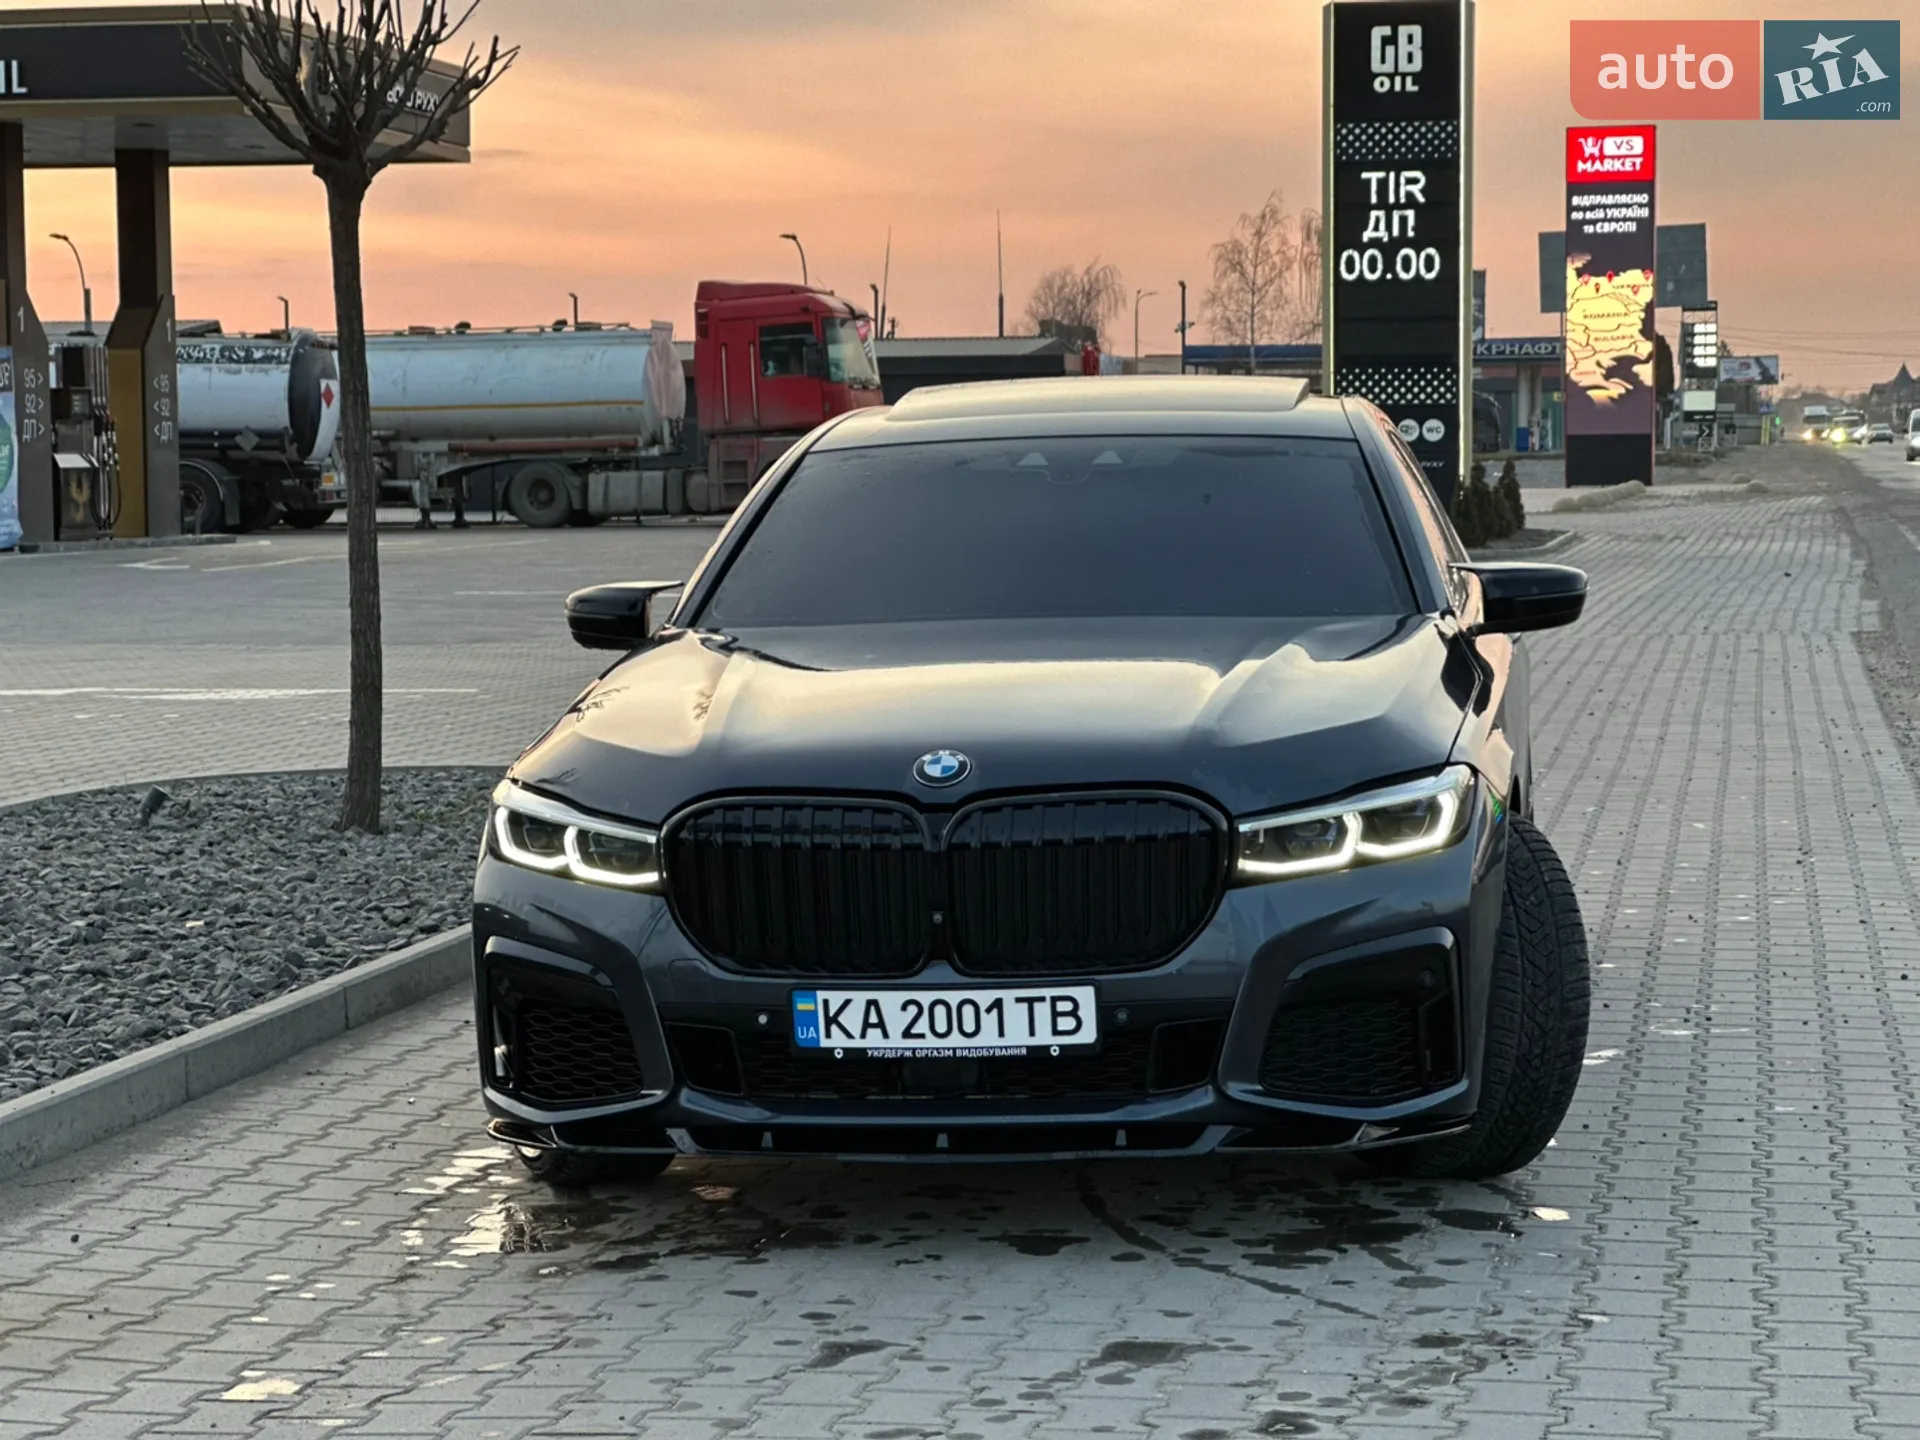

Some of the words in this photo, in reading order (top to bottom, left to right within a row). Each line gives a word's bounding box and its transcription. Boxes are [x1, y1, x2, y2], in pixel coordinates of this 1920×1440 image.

[1371, 24, 1422, 73] GB
[1373, 76, 1419, 92] OIL
[1613, 139, 1634, 151] VS
[1577, 157, 1644, 173] MARKET
[1361, 171, 1426, 203] TIR
[1571, 193, 1649, 206] ВІДПРАВЛЯЄМО
[1606, 205, 1649, 219] УКРАЇНІ
[1362, 209, 1415, 242] ДП
[1596, 221, 1637, 233] ЄВРОПІ
[1339, 248, 1440, 280] 00.00
[17, 306, 24, 332] 1
[165, 318, 172, 342] 1
[24, 368, 36, 389] 95
[25, 394, 37, 413] 92
[1425, 425, 1442, 434] WC
[821, 998, 890, 1040] KA
[900, 998, 1006, 1040] 2001
[1014, 995, 1083, 1038] TB
[798, 1026, 817, 1039] UA
[866, 1048, 913, 1059] УКРДЕРЖ
[915, 1048, 953, 1058] ОРГАЗМ
[956, 1046, 1027, 1058] ВИДОБУВАННЯ
